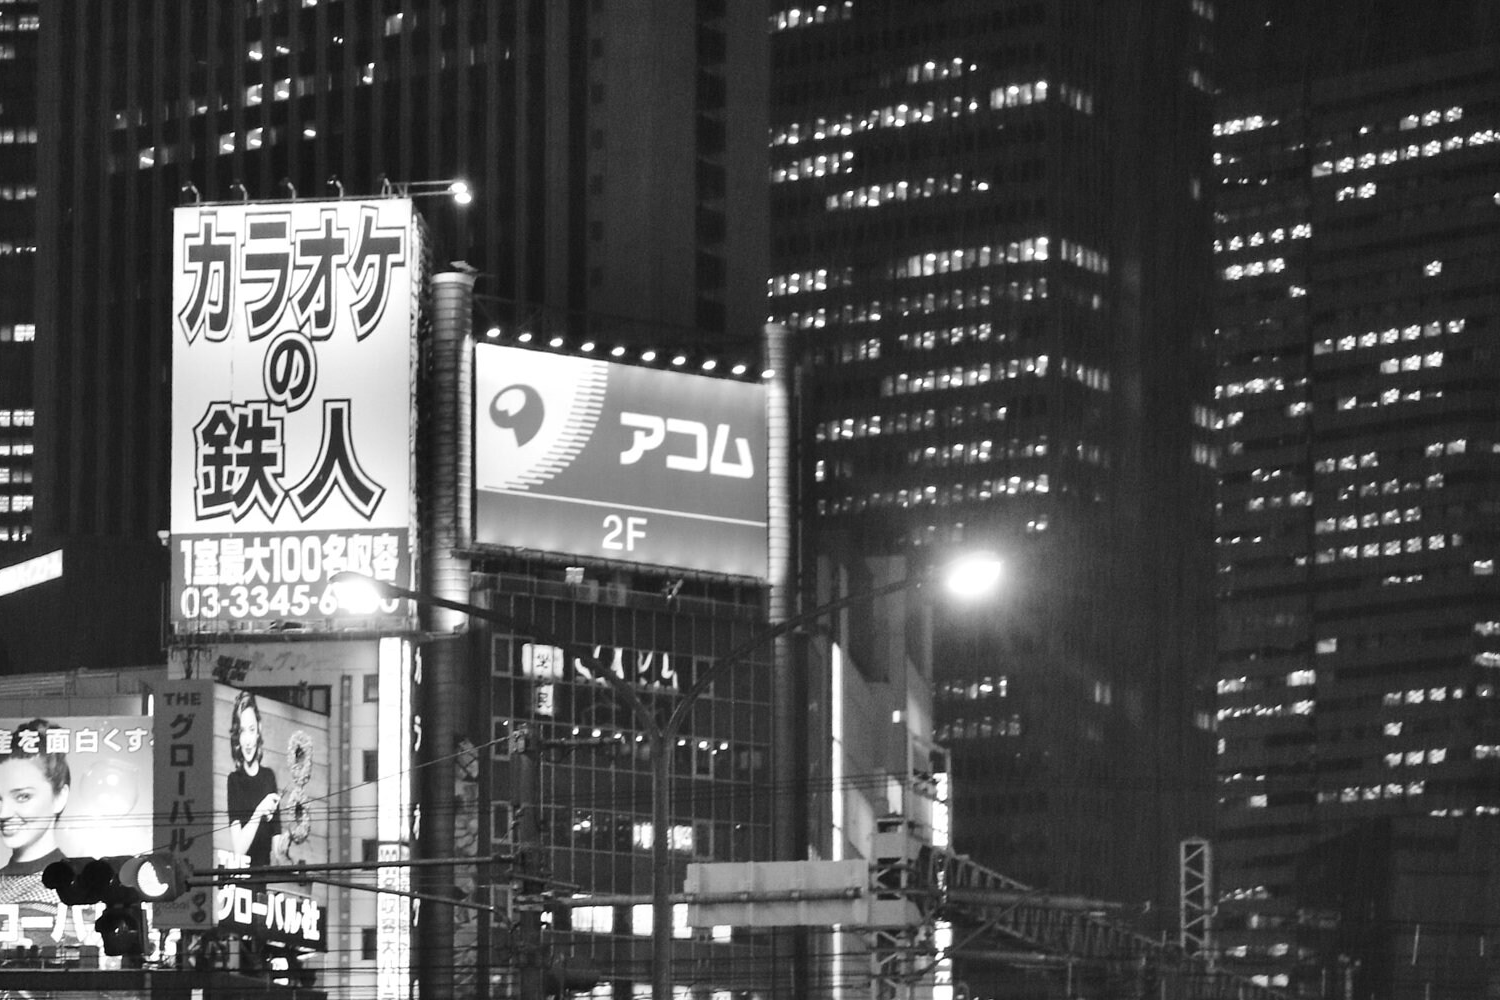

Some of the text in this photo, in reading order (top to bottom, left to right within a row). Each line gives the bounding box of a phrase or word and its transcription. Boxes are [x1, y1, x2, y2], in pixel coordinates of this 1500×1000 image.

[178, 206, 406, 344] カラオケ
[263, 330, 317, 412] の
[193, 398, 387, 523] 鉄人
[619, 411, 755, 480] アコム
[180, 532, 400, 586] 1室最大100名収容
[602, 514, 648, 551] 2F
[164, 692, 202, 706] THE
[168, 712, 197, 878] グローバル
[217, 884, 321, 941] グローバル社
